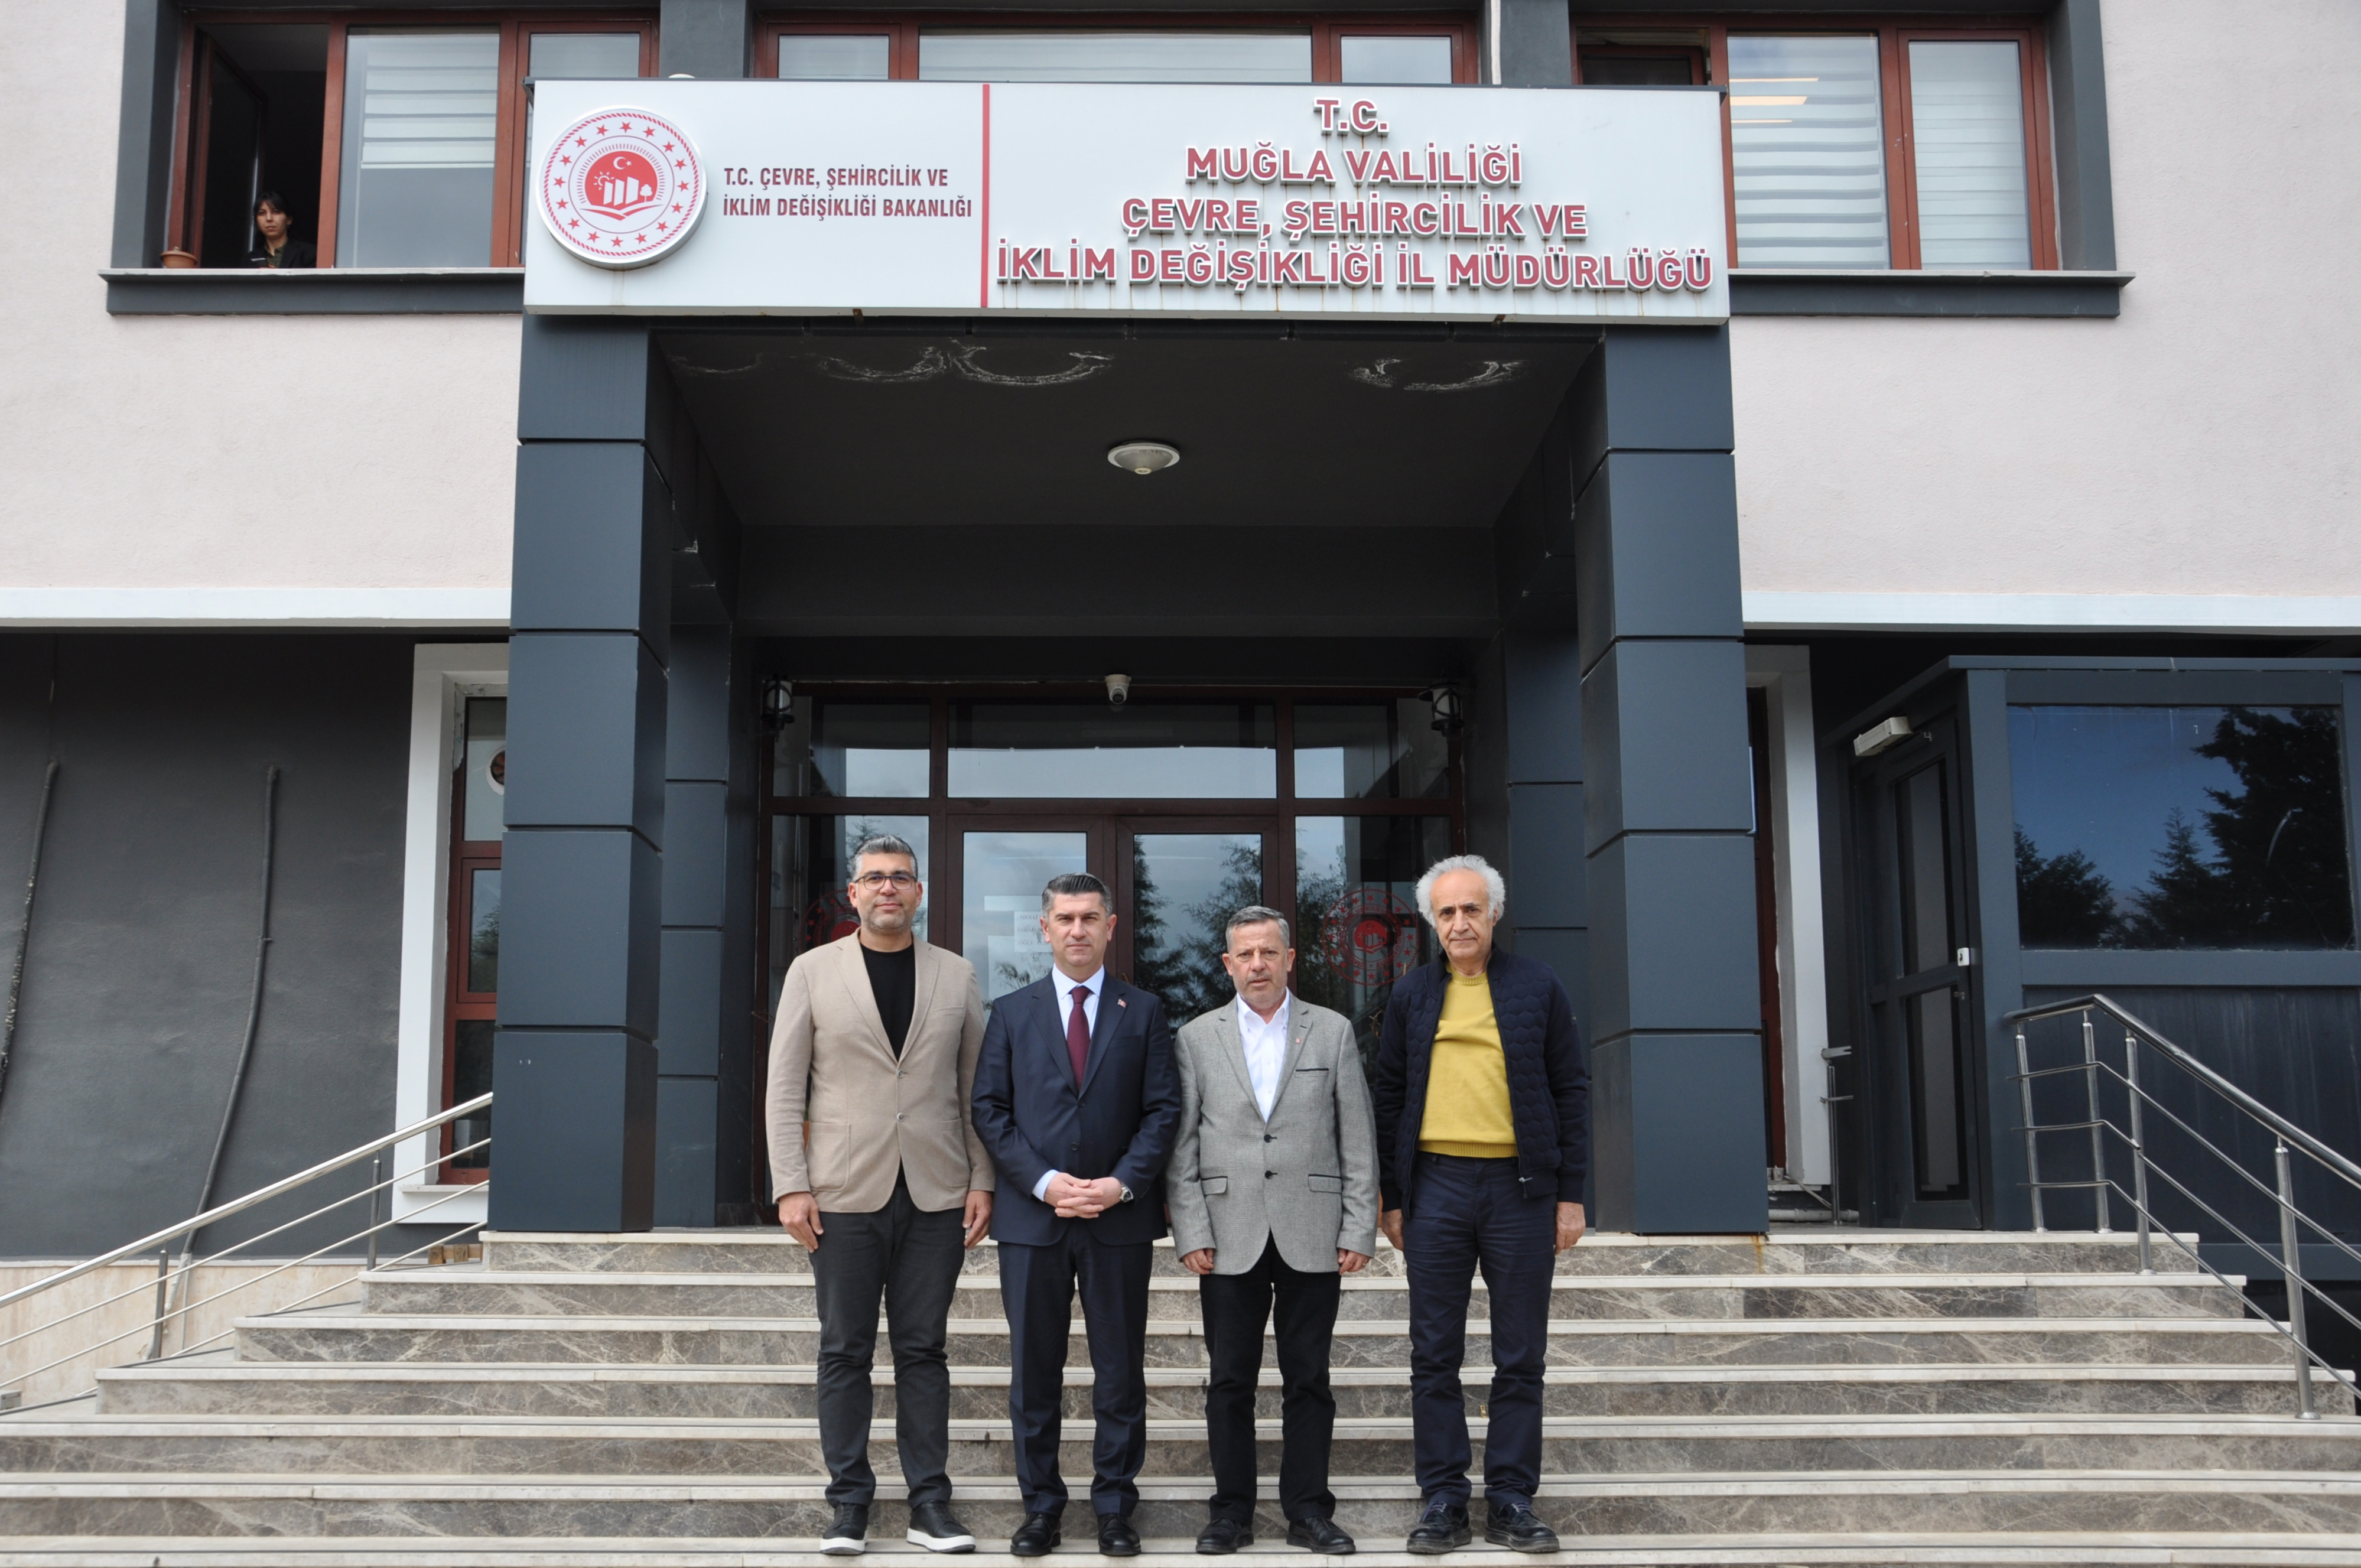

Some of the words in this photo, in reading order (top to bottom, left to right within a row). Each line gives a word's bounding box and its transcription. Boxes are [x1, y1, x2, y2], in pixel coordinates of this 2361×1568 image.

[1315, 97, 1389, 132] T.C.
[724, 168, 754, 186] T.C.
[760, 168, 820, 190] ÇEVRE,
[827, 164, 921, 190] ŞEHİRCİLİK
[928, 169, 948, 187] VE
[1186, 141, 1335, 183] MUĞLA
[1344, 142, 1522, 184] VALİLİĞİ
[723, 194, 770, 216] İKLİM
[777, 194, 876, 221] DEĞİŞİKLİĞİ
[883, 195, 972, 217] BAKANLIĞI
[1121, 197, 1272, 240] ÇEVRE,
[1283, 191, 1524, 244] ŞEHİRCİLİK
[1533, 203, 1588, 236] VE
[997, 237, 1117, 281] İKLİM
[1129, 239, 1384, 292] DEĞİŞİKLİĞİ
[1397, 242, 1437, 285] İL
[1447, 244, 1713, 290] MÜDÜRLÜĞÜ
